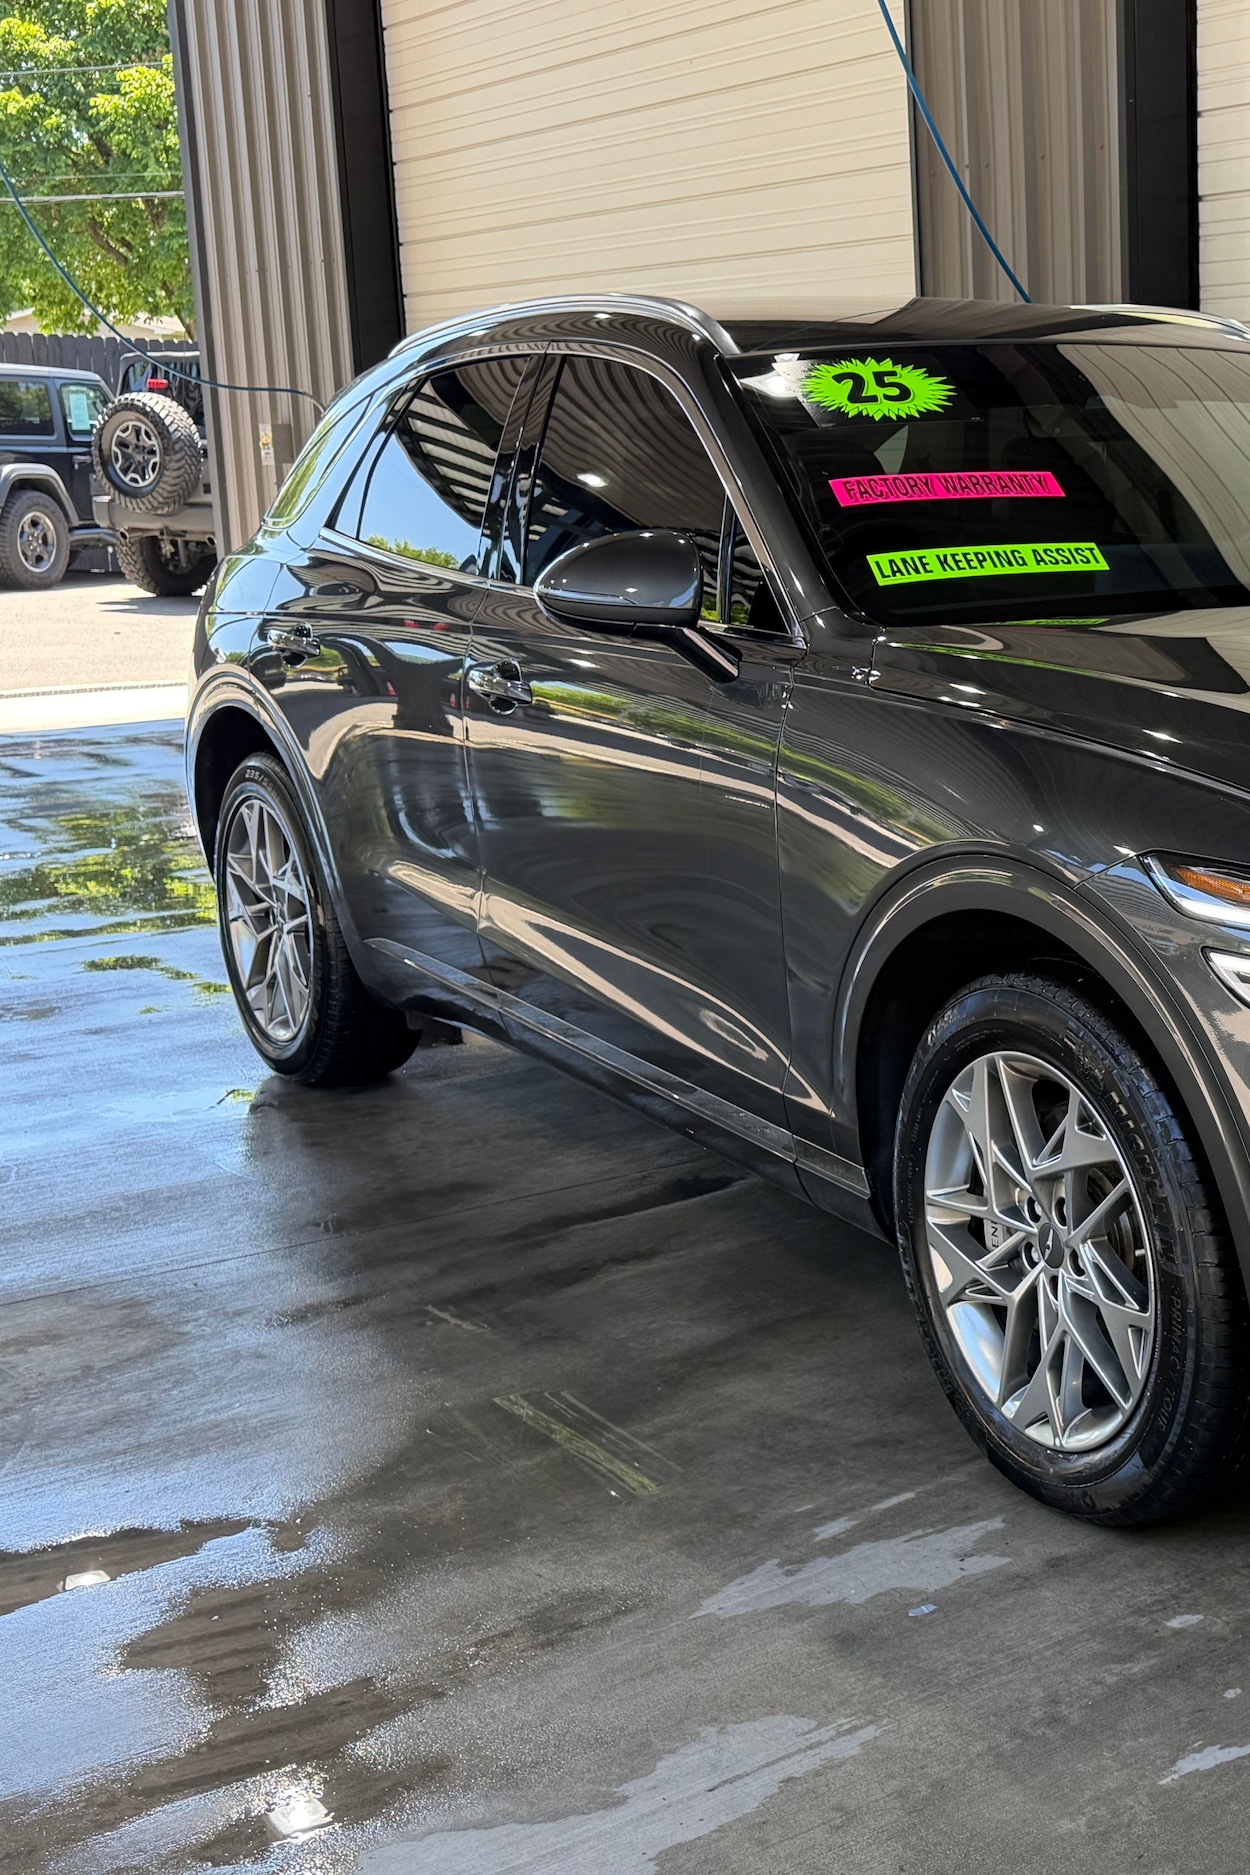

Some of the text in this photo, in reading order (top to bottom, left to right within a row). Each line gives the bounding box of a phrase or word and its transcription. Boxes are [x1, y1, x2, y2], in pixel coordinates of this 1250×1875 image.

[832, 370, 914, 404] 25
[843, 473, 1047, 500] FACTORY WARRANTY
[874, 547, 1102, 579] LANE KEEPING ASSIST
